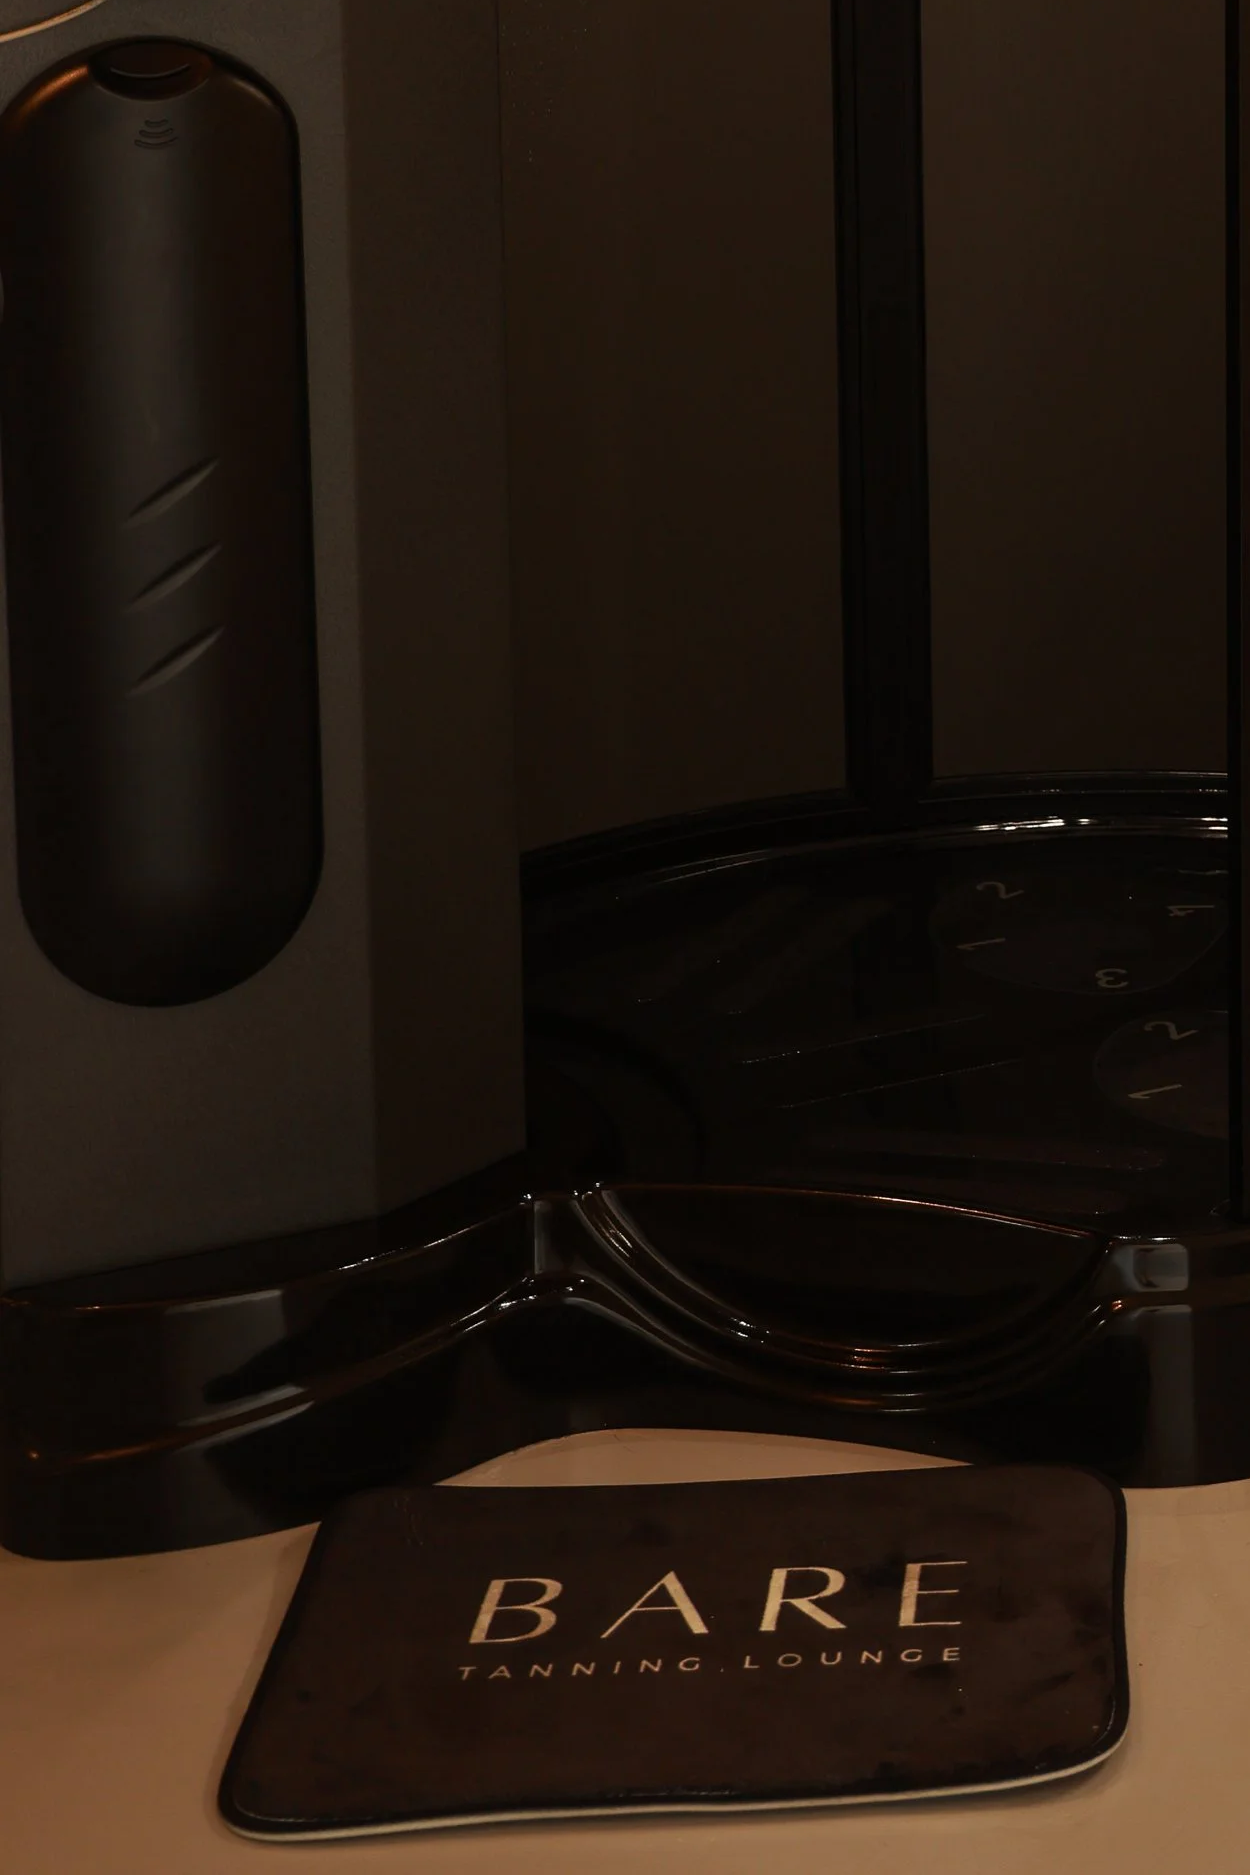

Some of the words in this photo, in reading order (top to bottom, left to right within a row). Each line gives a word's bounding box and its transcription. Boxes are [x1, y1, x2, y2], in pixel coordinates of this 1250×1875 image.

[468, 1560, 968, 1645] BARE
[457, 1656, 701, 1681] TANNING
[742, 1646, 963, 1669] LOUNGE
